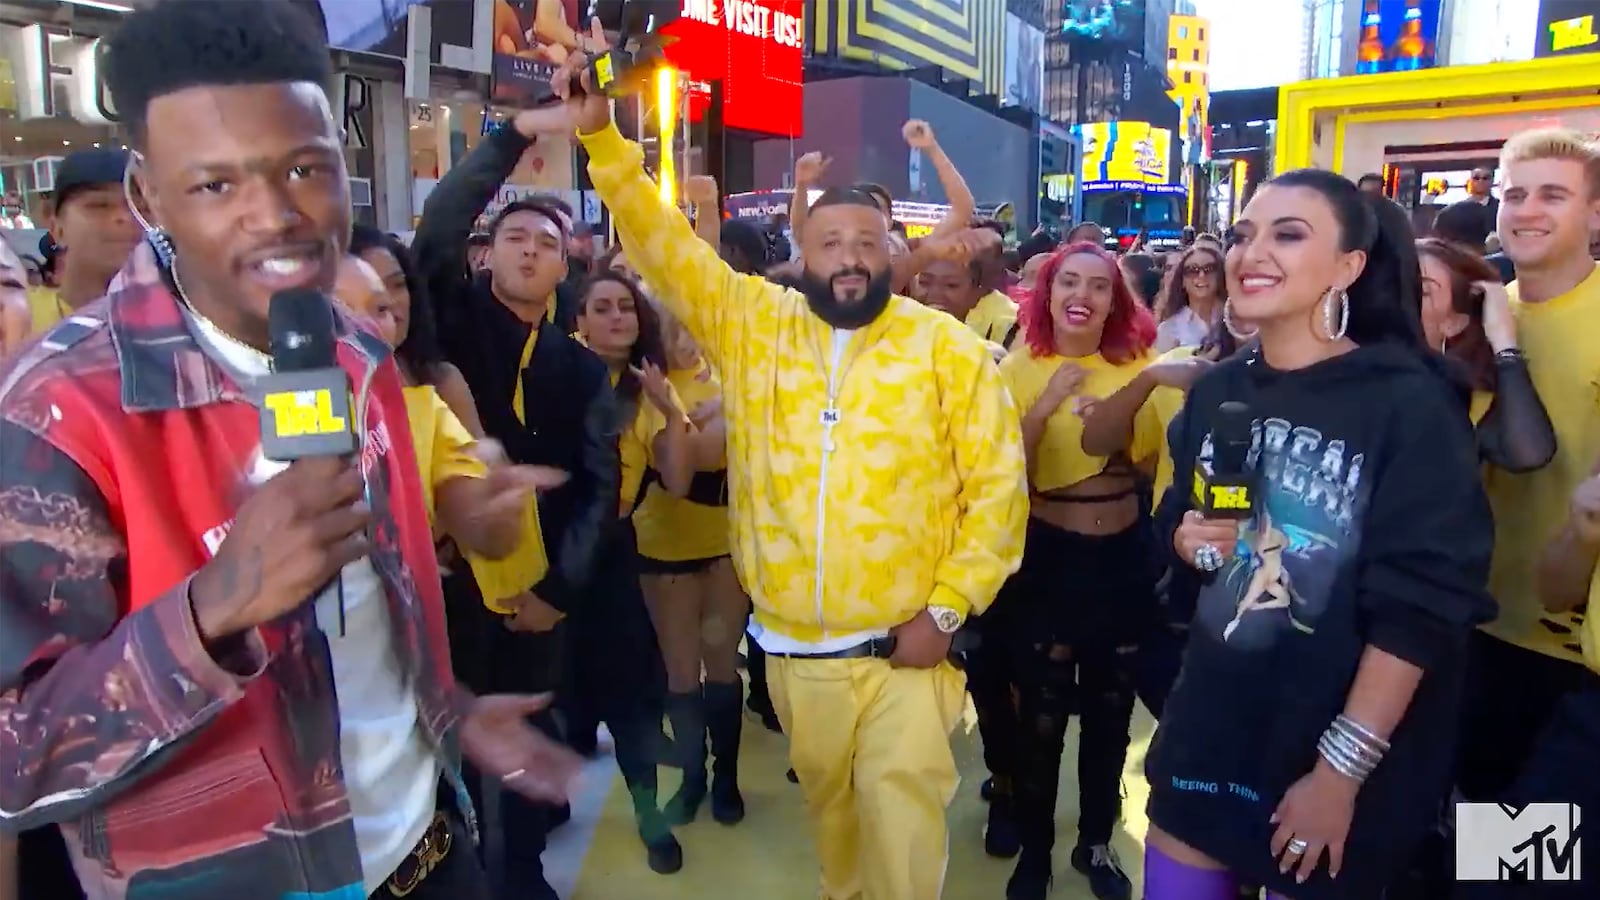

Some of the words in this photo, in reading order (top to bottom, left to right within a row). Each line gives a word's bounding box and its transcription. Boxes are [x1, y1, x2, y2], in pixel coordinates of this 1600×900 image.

[723, 0, 770, 38] VISIT
[774, 11, 802, 48] US!
[265, 389, 345, 437] TRL
